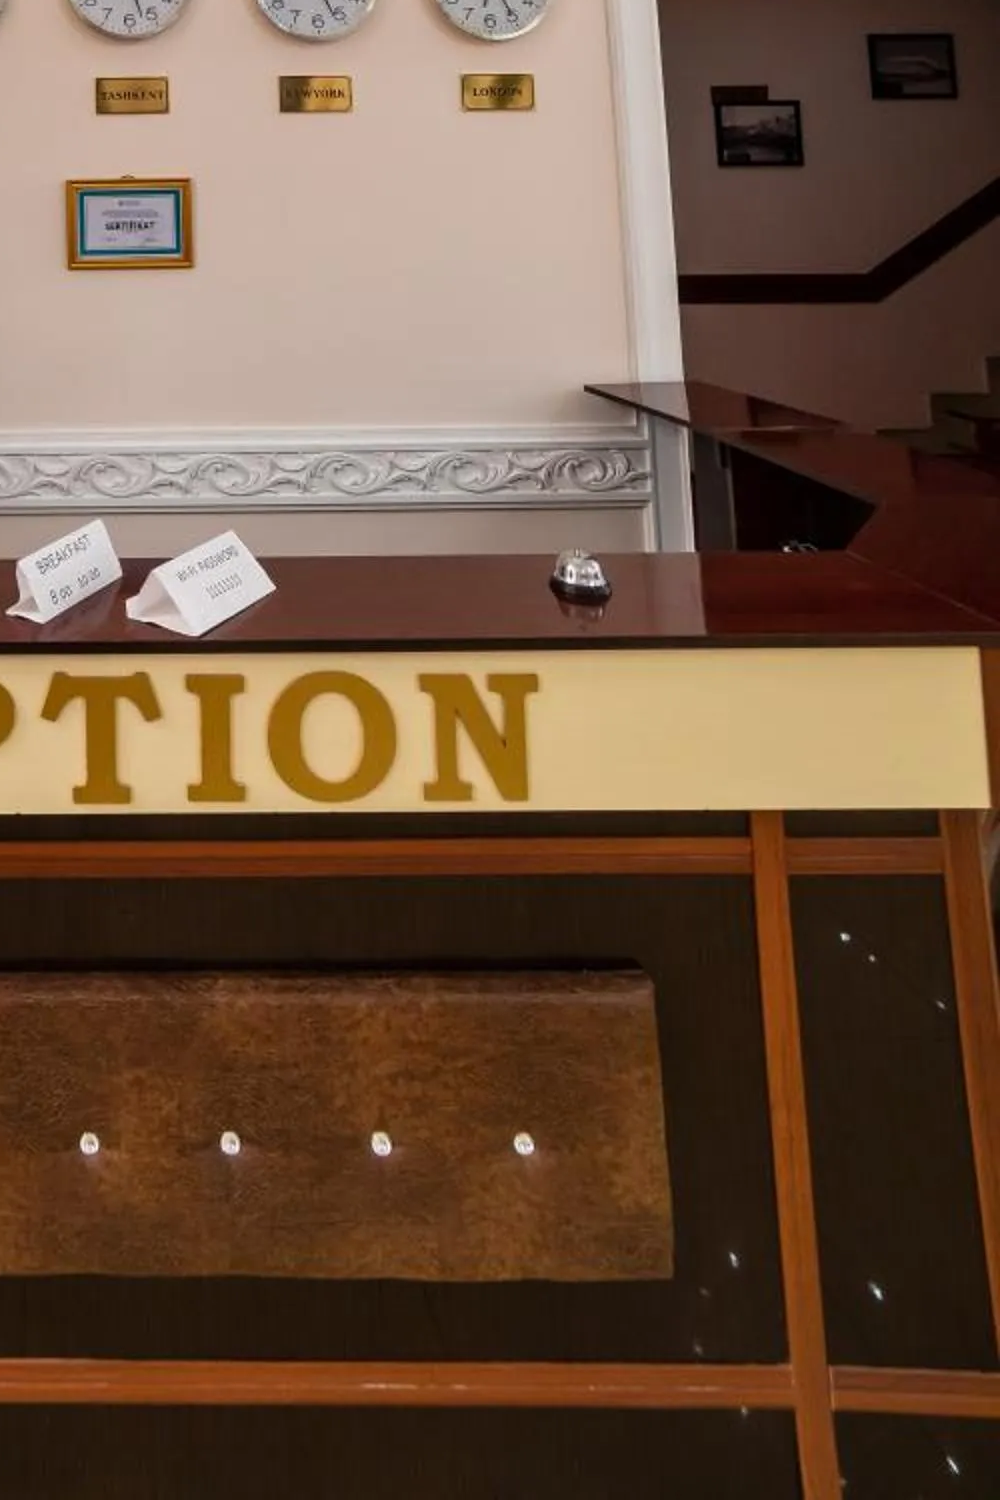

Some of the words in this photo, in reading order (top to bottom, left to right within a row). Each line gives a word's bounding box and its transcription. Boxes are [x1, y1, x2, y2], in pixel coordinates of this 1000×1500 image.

[102, 7, 113, 21] 7
[123, 13, 137, 28] 6
[145, 5, 158, 21] 5
[289, 9, 303, 25] 7
[463, 7, 476, 21] 7
[311, 13, 326, 29] 6
[483, 13, 497, 29] 6
[102, 90, 164, 102] TASHKENT
[472, 86, 523, 98] LONDON
[35, 533, 90, 575] BREAKFAST
